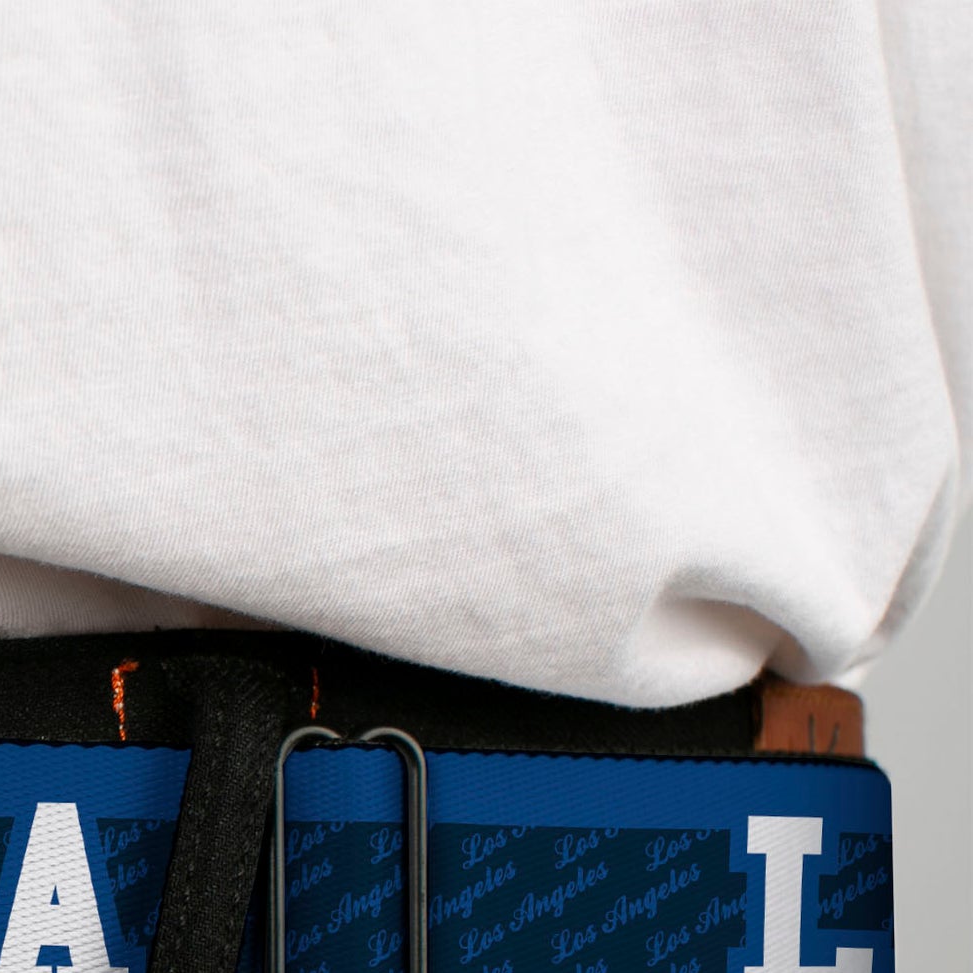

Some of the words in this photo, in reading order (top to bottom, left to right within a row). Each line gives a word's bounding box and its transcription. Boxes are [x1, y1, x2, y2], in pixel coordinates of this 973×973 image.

[370, 826, 402, 865] Lo
[461, 829, 507, 871] Los
[554, 829, 601, 870] Los
[645, 831, 692, 872] Los
[290, 857, 333, 898] eles
[817, 866, 889, 920] ngeles
[328, 864, 402, 934] Angel
[459, 922, 505, 965] Los
[509, 861, 608, 932] Angeles
[551, 924, 598, 965] Los
[602, 863, 701, 934] Angeles
[367, 928, 402, 968] Lo
[645, 925, 691, 967] Los
